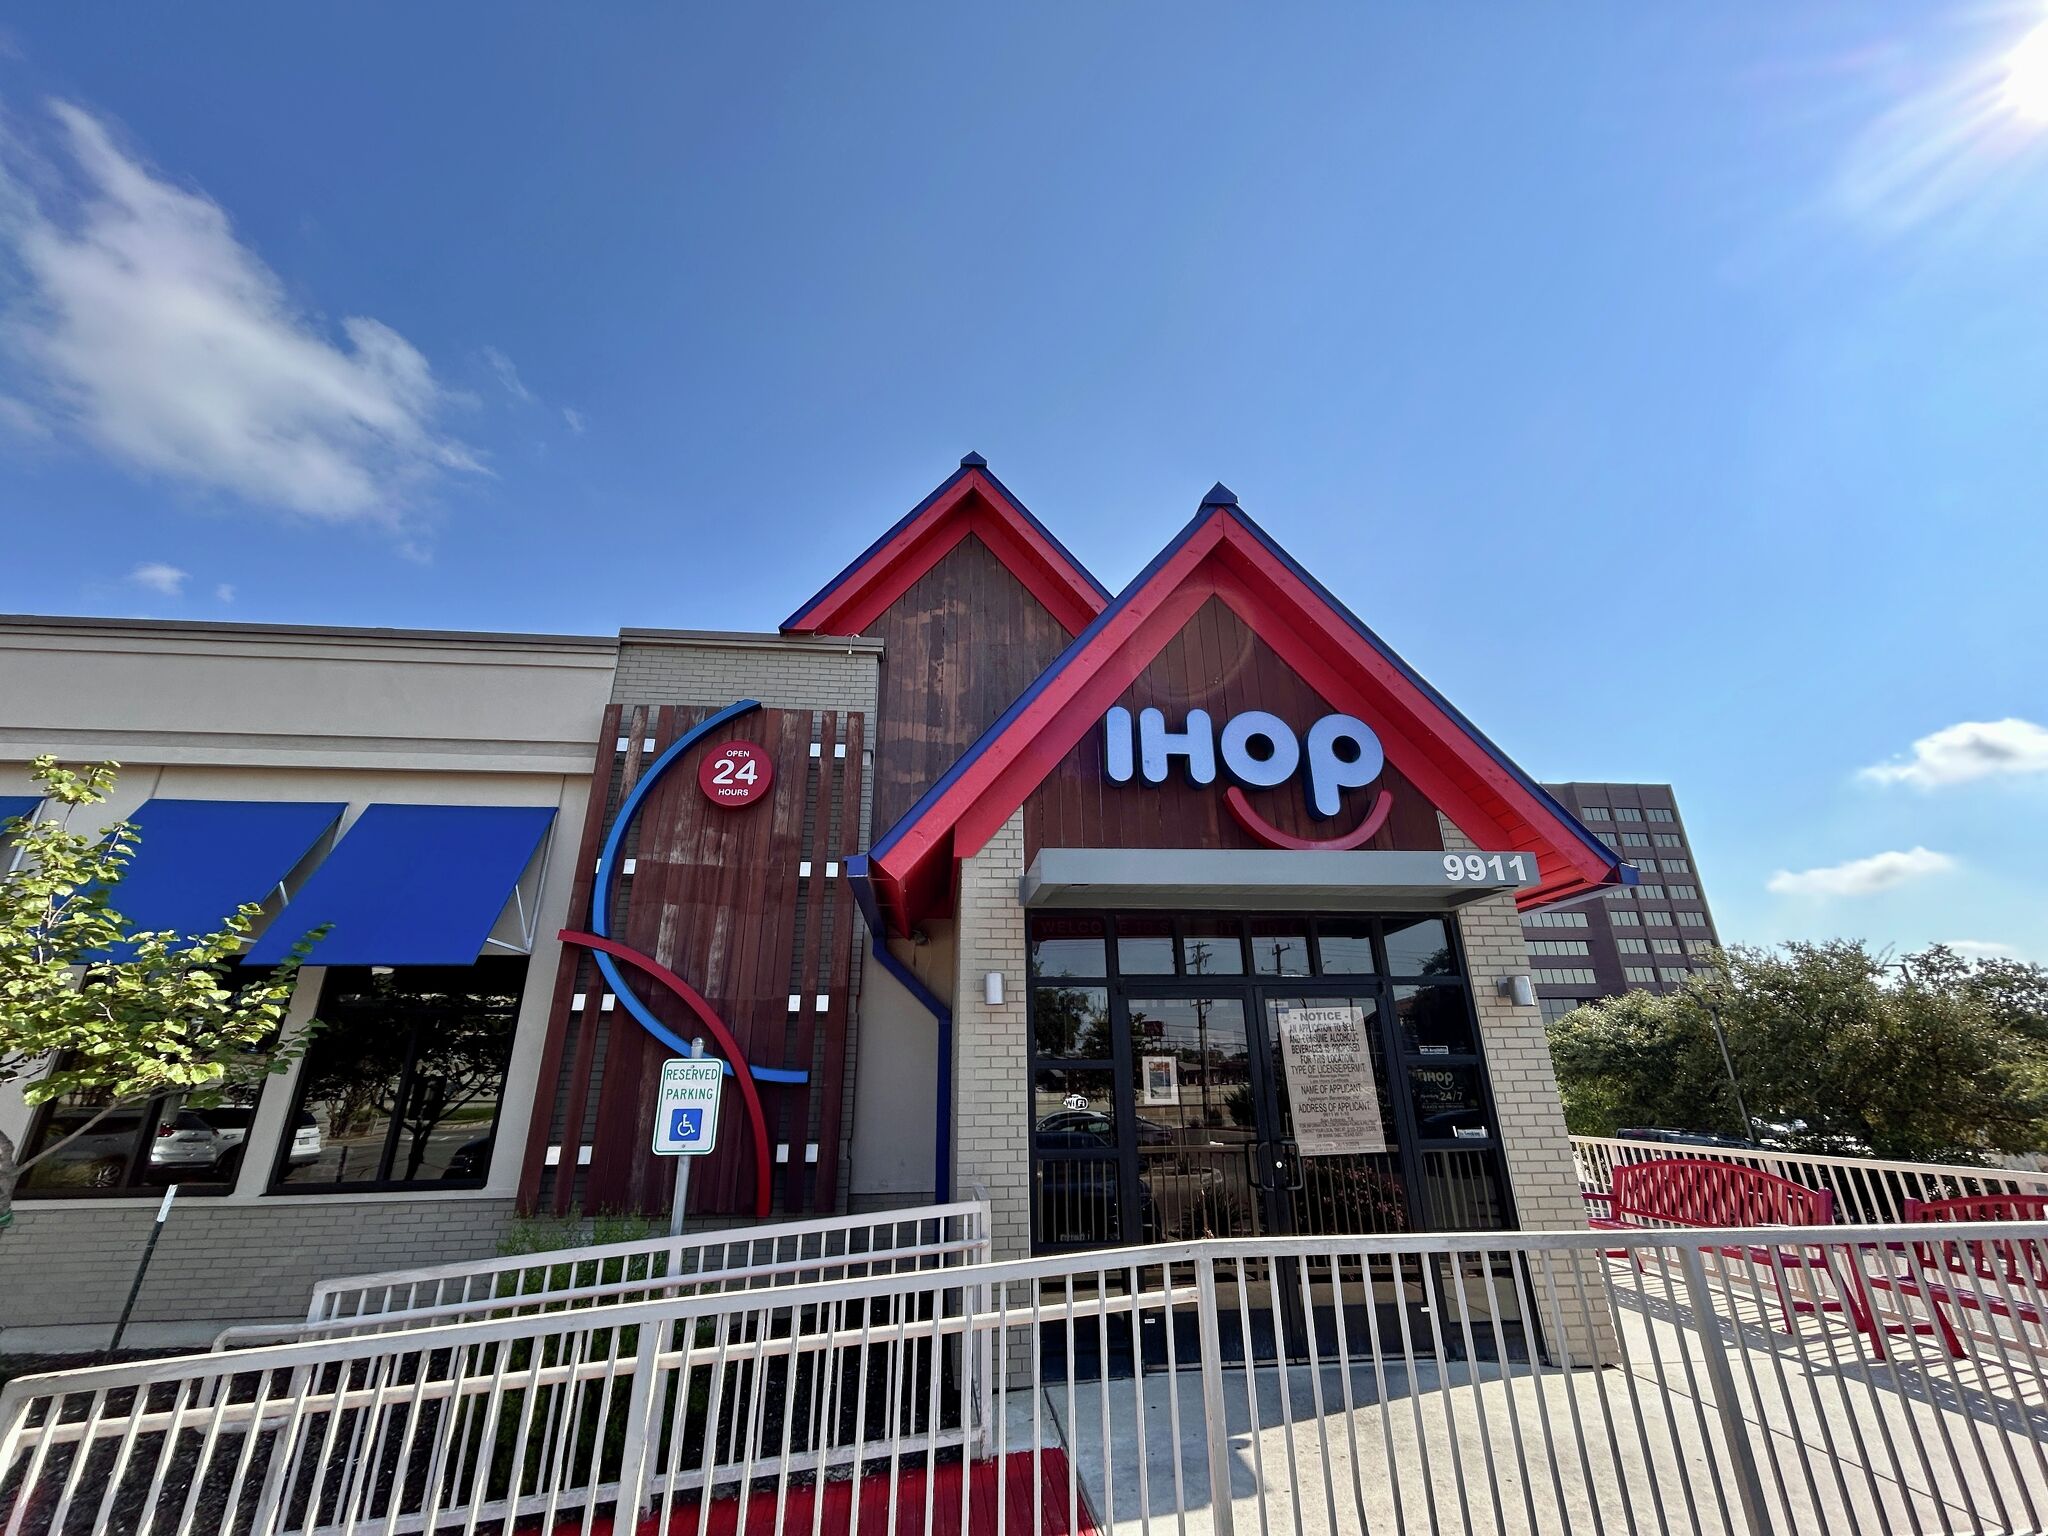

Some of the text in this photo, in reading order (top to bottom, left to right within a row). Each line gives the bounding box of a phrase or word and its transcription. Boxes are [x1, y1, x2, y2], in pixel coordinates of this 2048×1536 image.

[712, 759, 758, 785] 24
[718, 788, 749, 796] HOURS
[1443, 854, 1527, 881] 9911
[1299, 1011, 1342, 1021] NOTICE
[1342, 1021, 1356, 1032] SELL
[1330, 1032, 1359, 1043] ALCOHOLIC
[1291, 1044, 1323, 1054] BEVERAGES
[1332, 1042, 1360, 1053] PROPOSED
[1300, 1055, 1311, 1064] FOR
[666, 1068, 718, 1080] RESERVED
[1291, 1065, 1307, 1075] TYPE
[1308, 1064, 1316, 1074] OF
[666, 1088, 713, 1100] PARKING
[1301, 1083, 1361, 1095] NAME OF APPLICANT
[1439, 1091, 1463, 1102] 24/7
[1298, 1101, 1370, 1113] ADDRESS OF APPLICANT
